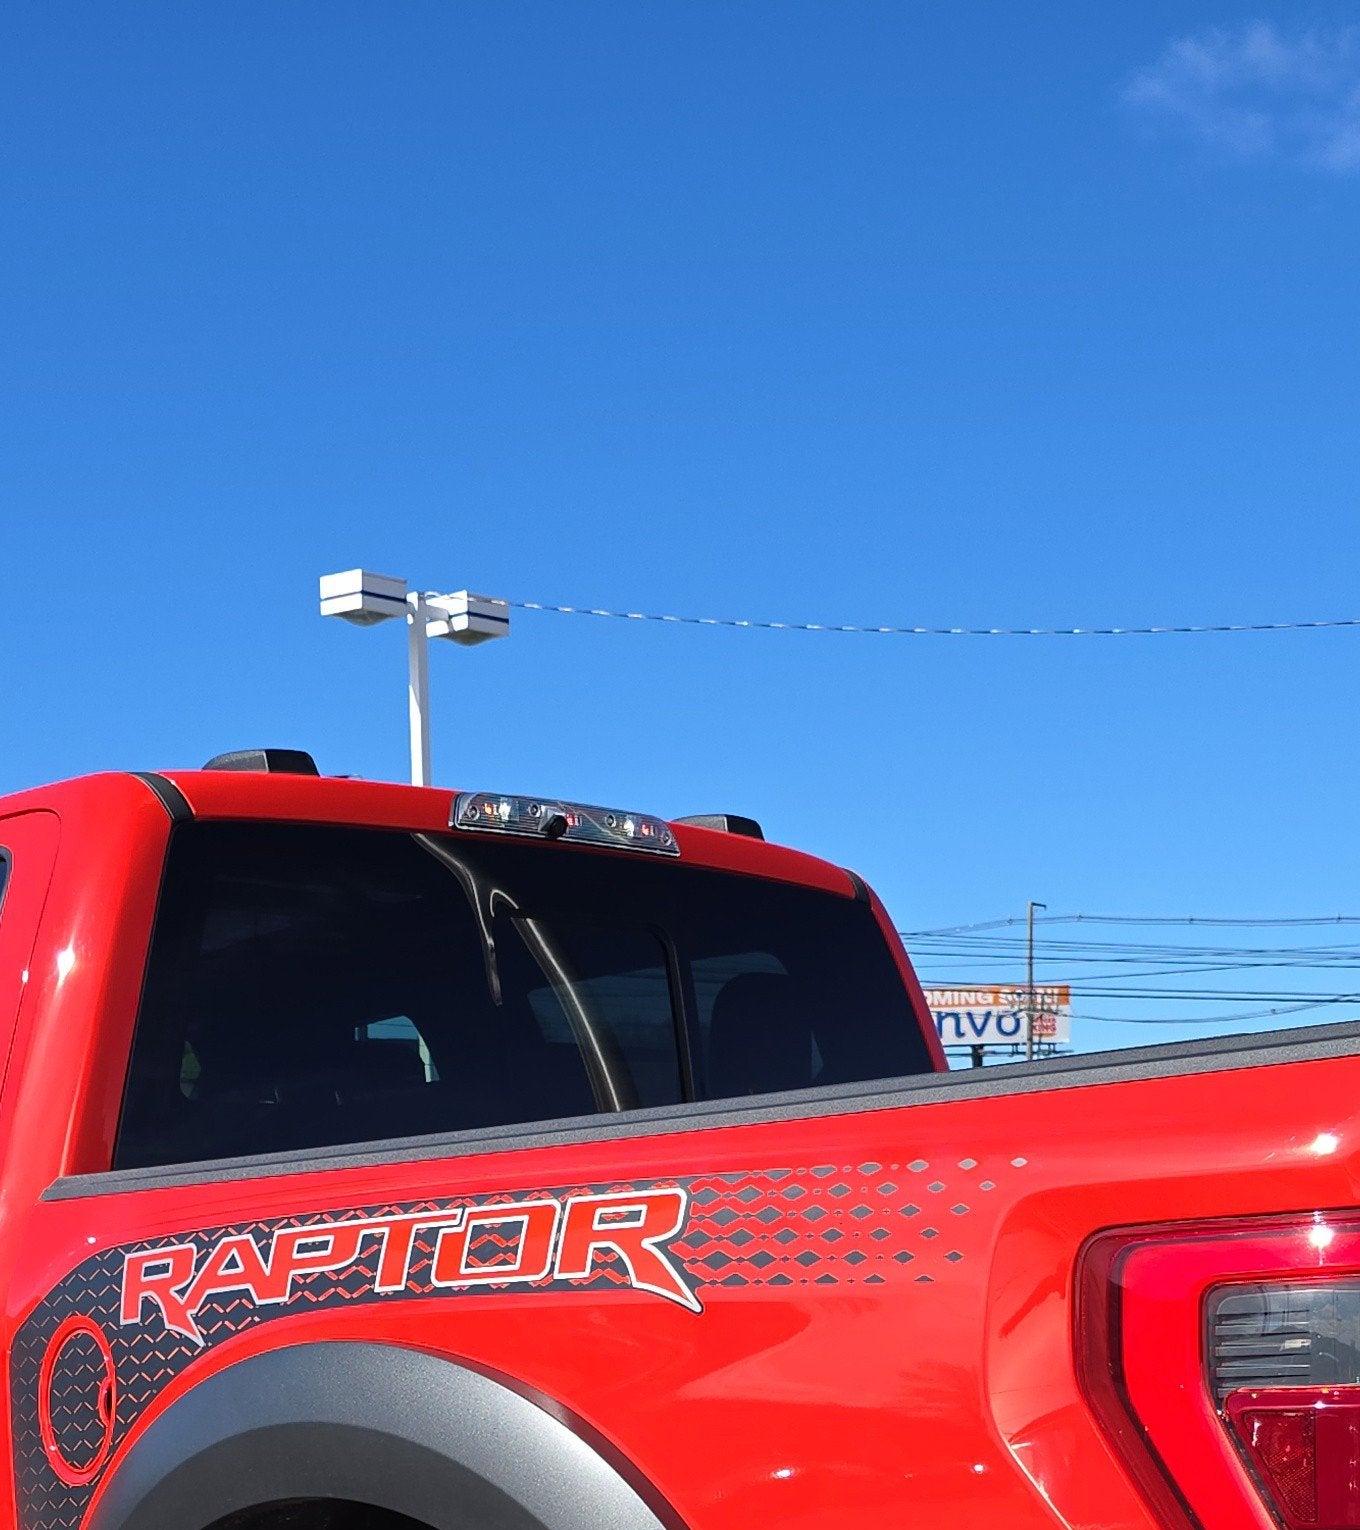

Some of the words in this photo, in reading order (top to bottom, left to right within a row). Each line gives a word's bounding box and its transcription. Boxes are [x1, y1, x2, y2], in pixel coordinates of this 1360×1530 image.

[924, 989, 994, 1005] OMING
[936, 1010, 1021, 1039] nvo
[120, 1187, 704, 1347] RAPTOR
